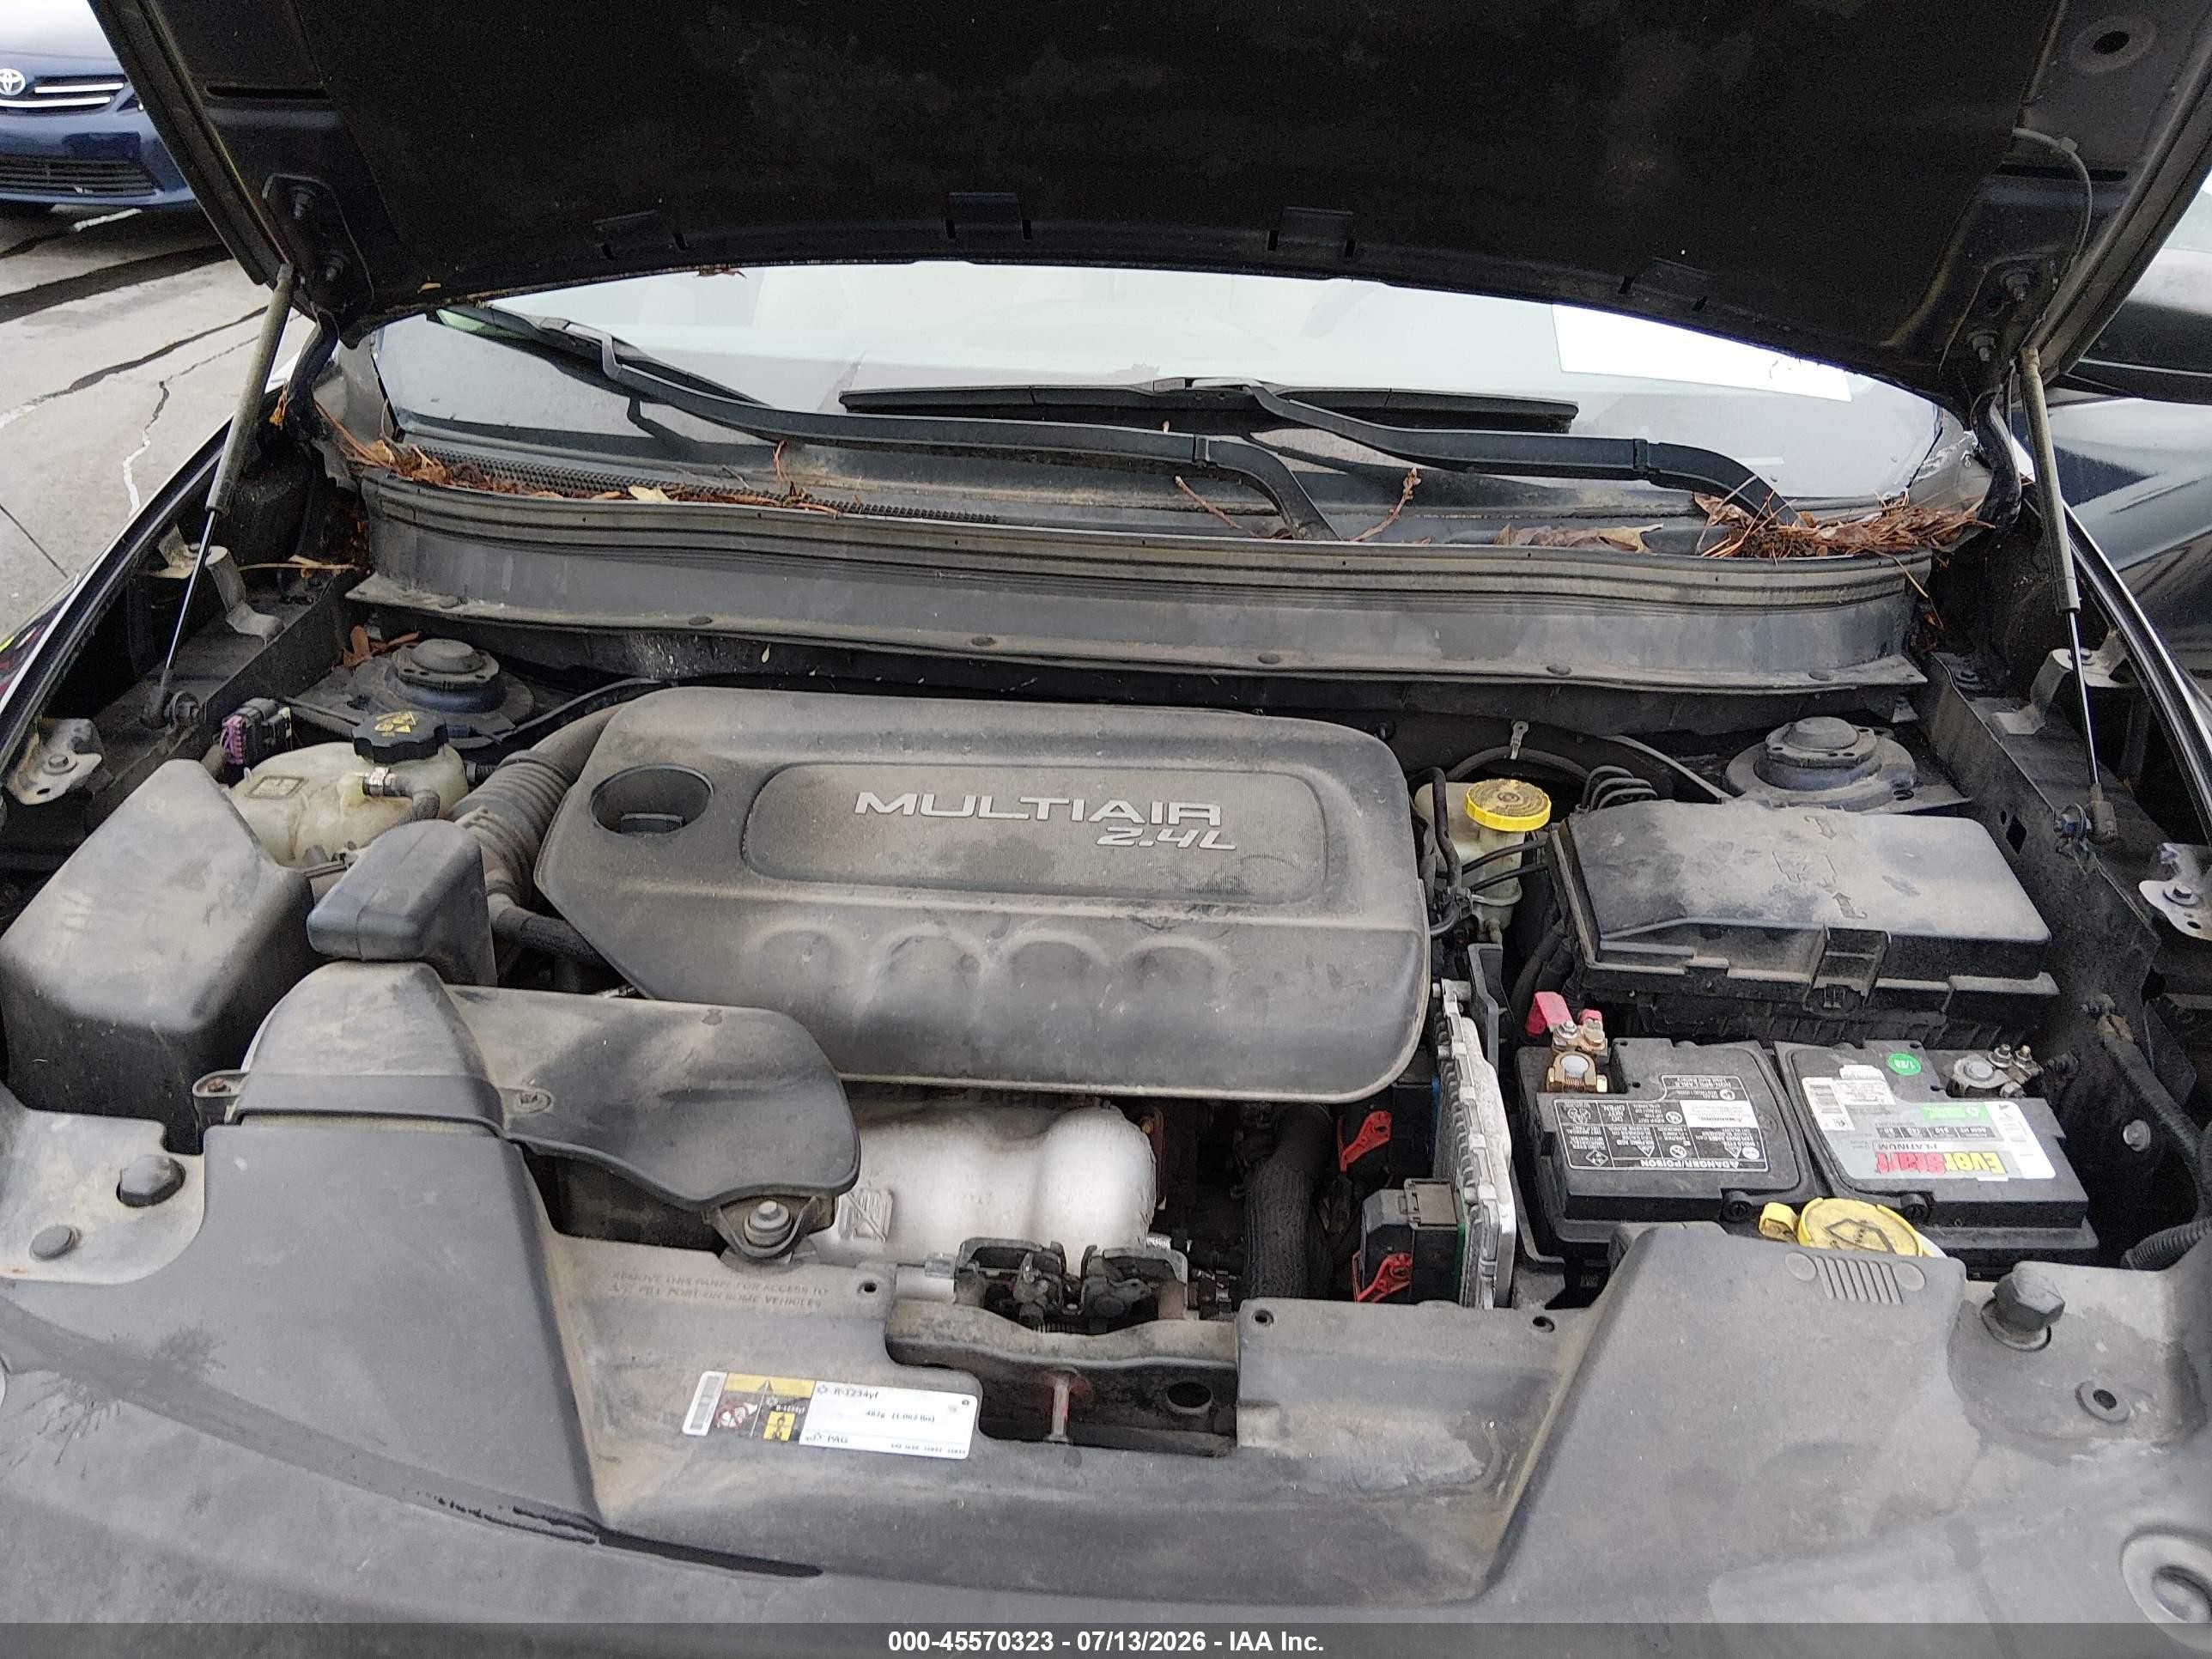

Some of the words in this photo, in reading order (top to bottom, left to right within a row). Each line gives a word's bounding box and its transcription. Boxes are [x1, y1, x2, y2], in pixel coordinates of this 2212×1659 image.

[855, 791, 1223, 826] MULTIAIR
[1097, 825, 1237, 851] 2.4L
[1877, 1142, 1938, 1151] PLATINUM
[1876, 1152, 2007, 1176] EverStart
